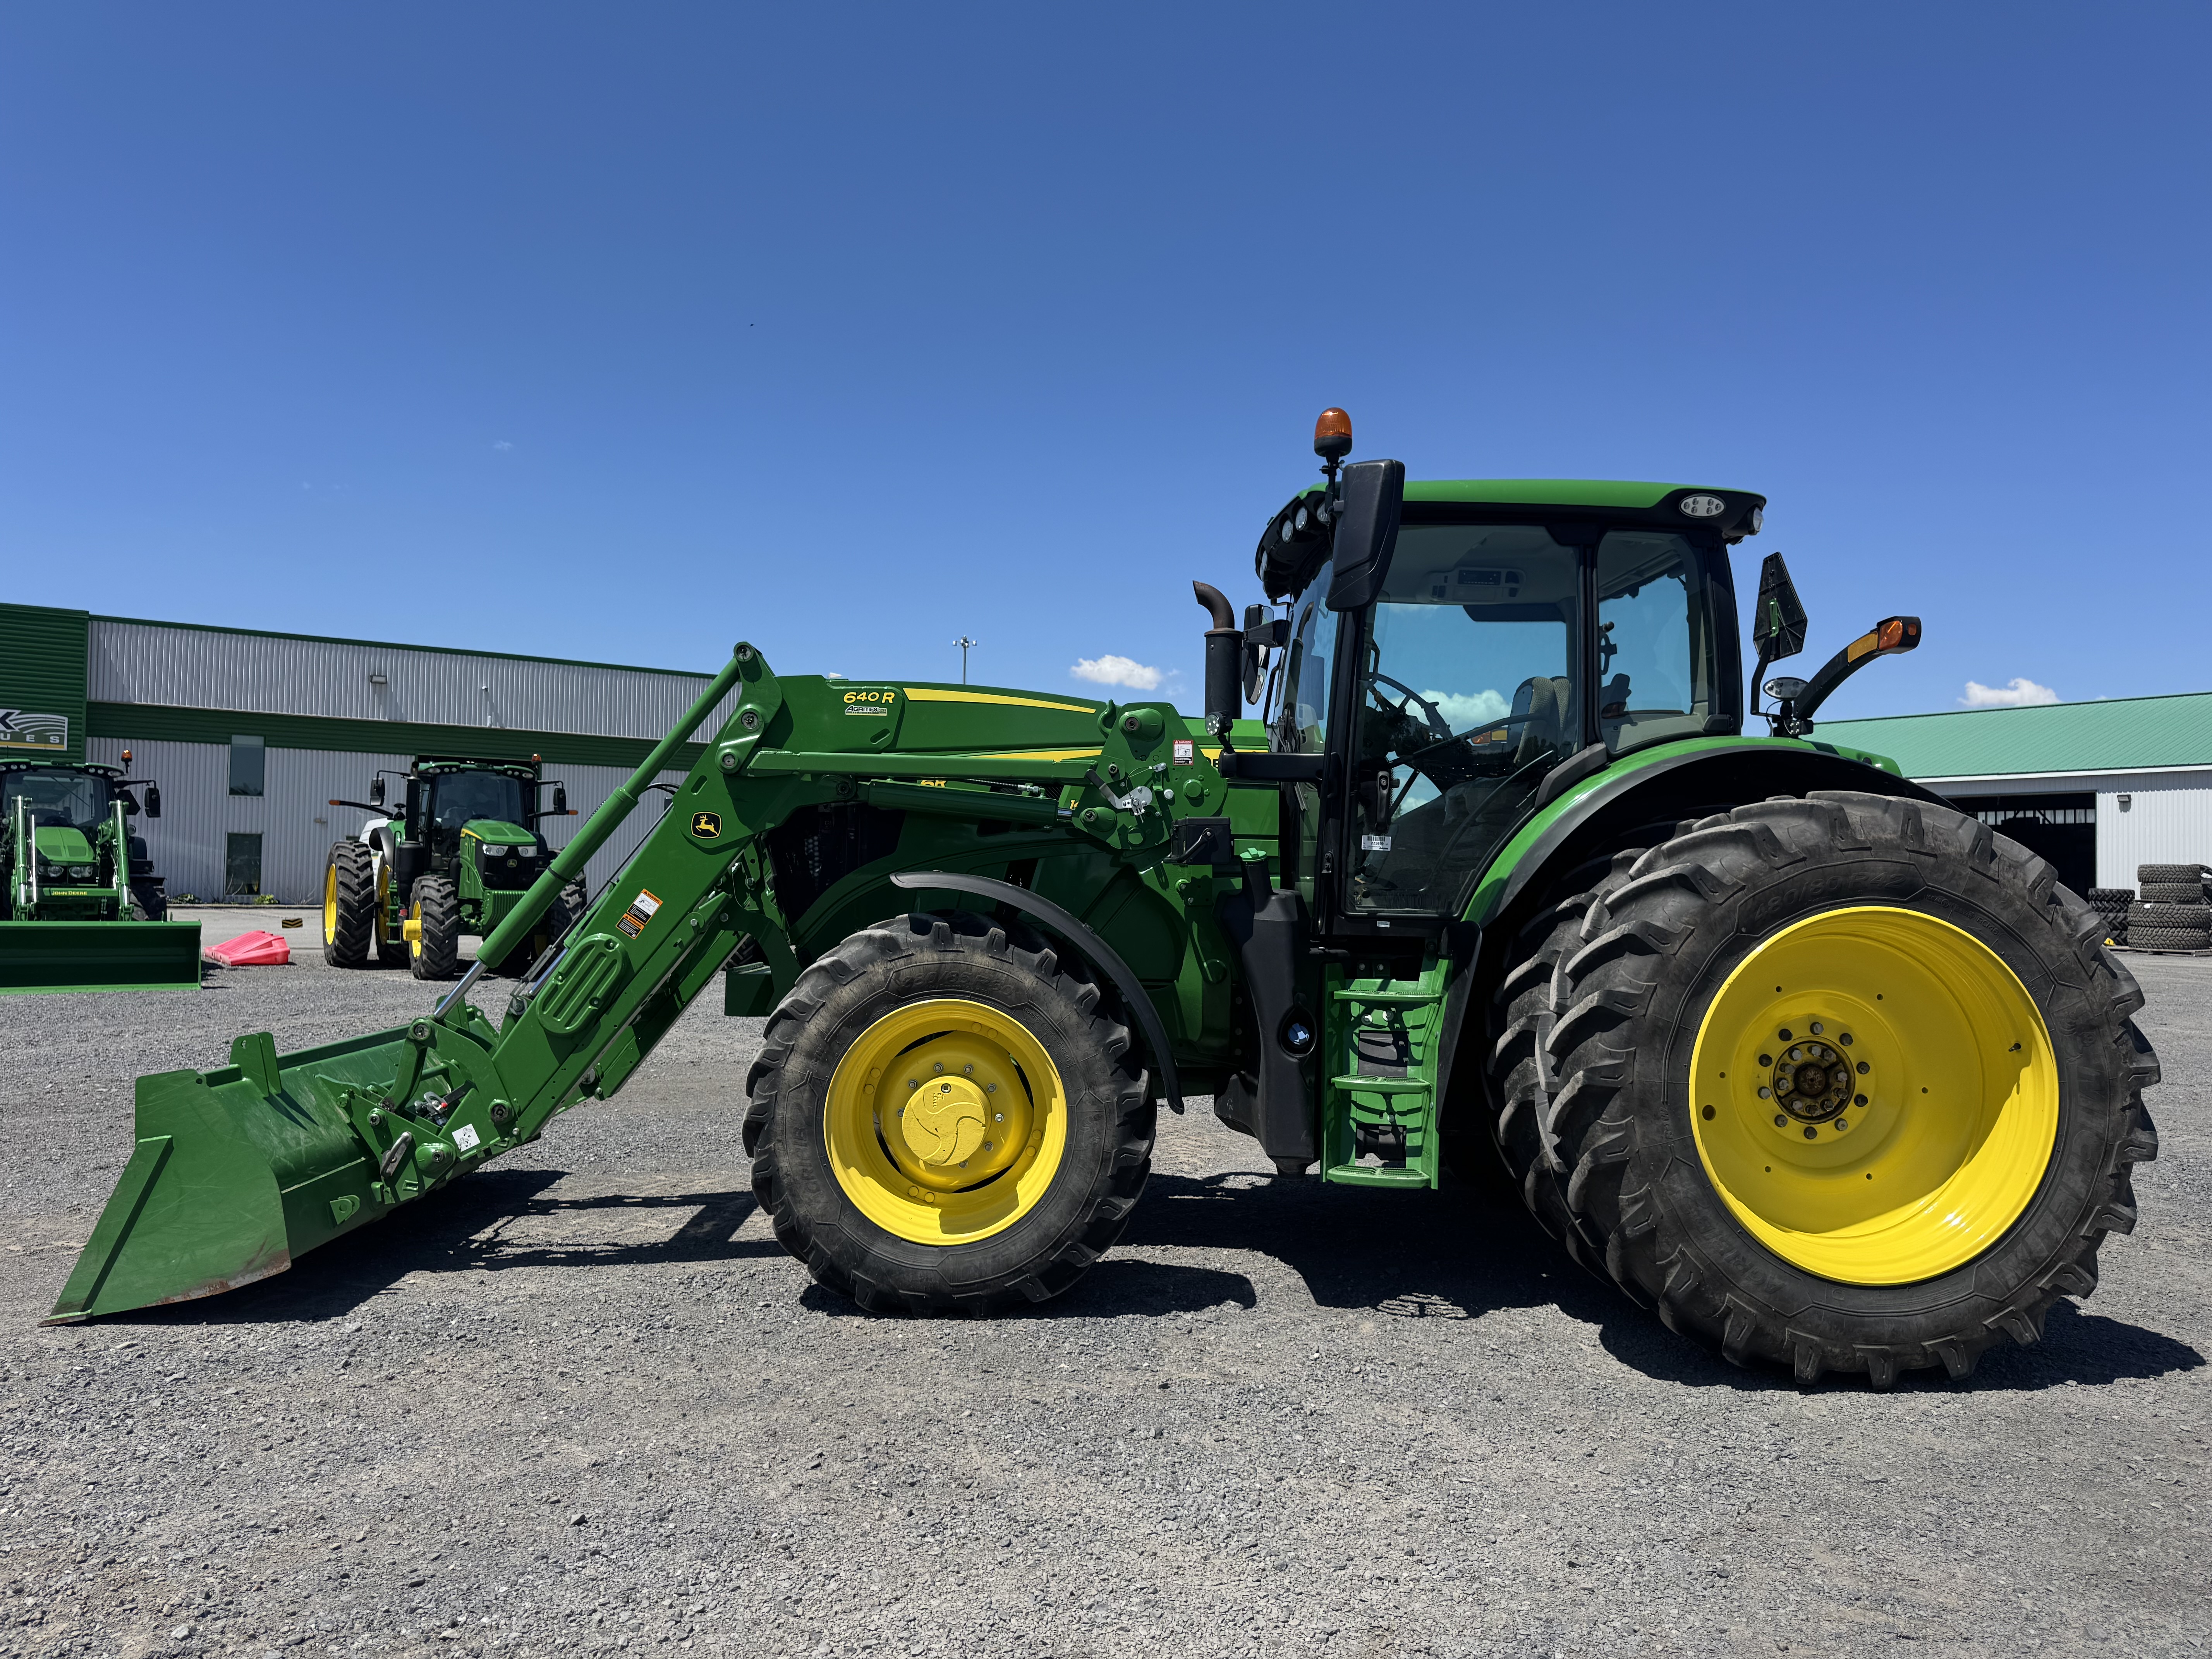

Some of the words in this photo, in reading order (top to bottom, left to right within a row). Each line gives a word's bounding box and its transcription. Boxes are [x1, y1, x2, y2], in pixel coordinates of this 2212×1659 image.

[843, 692, 879, 703] 640
[881, 692, 895, 703] R
[647, 893, 660, 903] WARNING
[1753, 876, 1842, 920] 480/80
[628, 917, 642, 928] WARNING
[902, 971, 972, 987] 380/85
